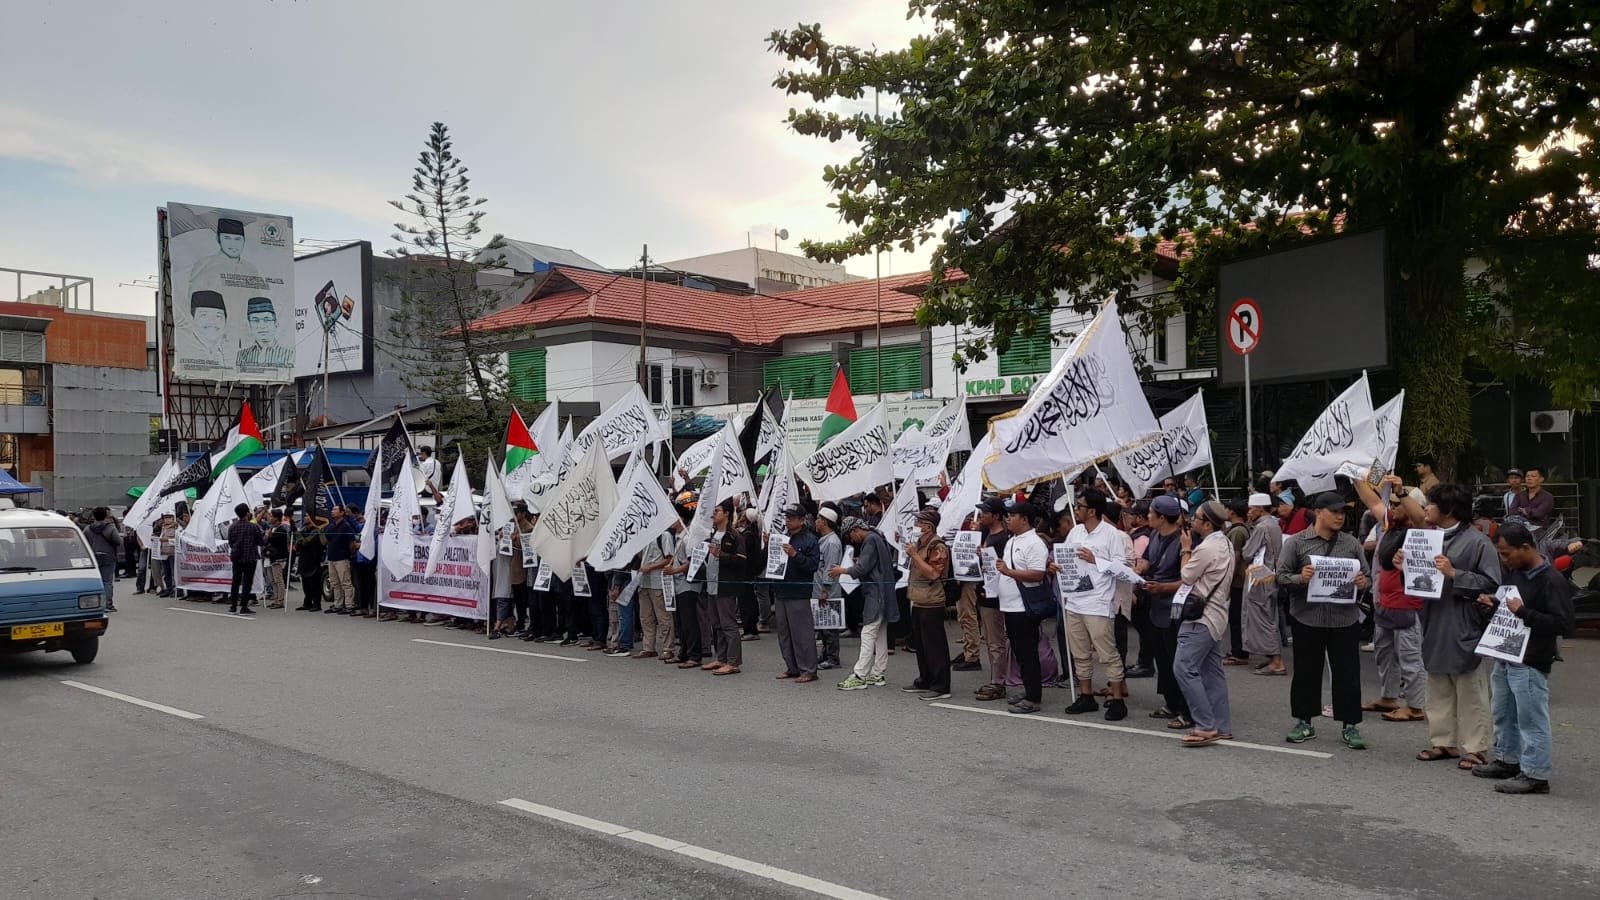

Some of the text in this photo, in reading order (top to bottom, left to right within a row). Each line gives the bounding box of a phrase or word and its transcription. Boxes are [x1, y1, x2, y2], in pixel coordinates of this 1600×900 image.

[965, 378, 1005, 395] KPHP
[1318, 571, 1348, 579] DENGAN
[1492, 616, 1520, 630] ENGAN
